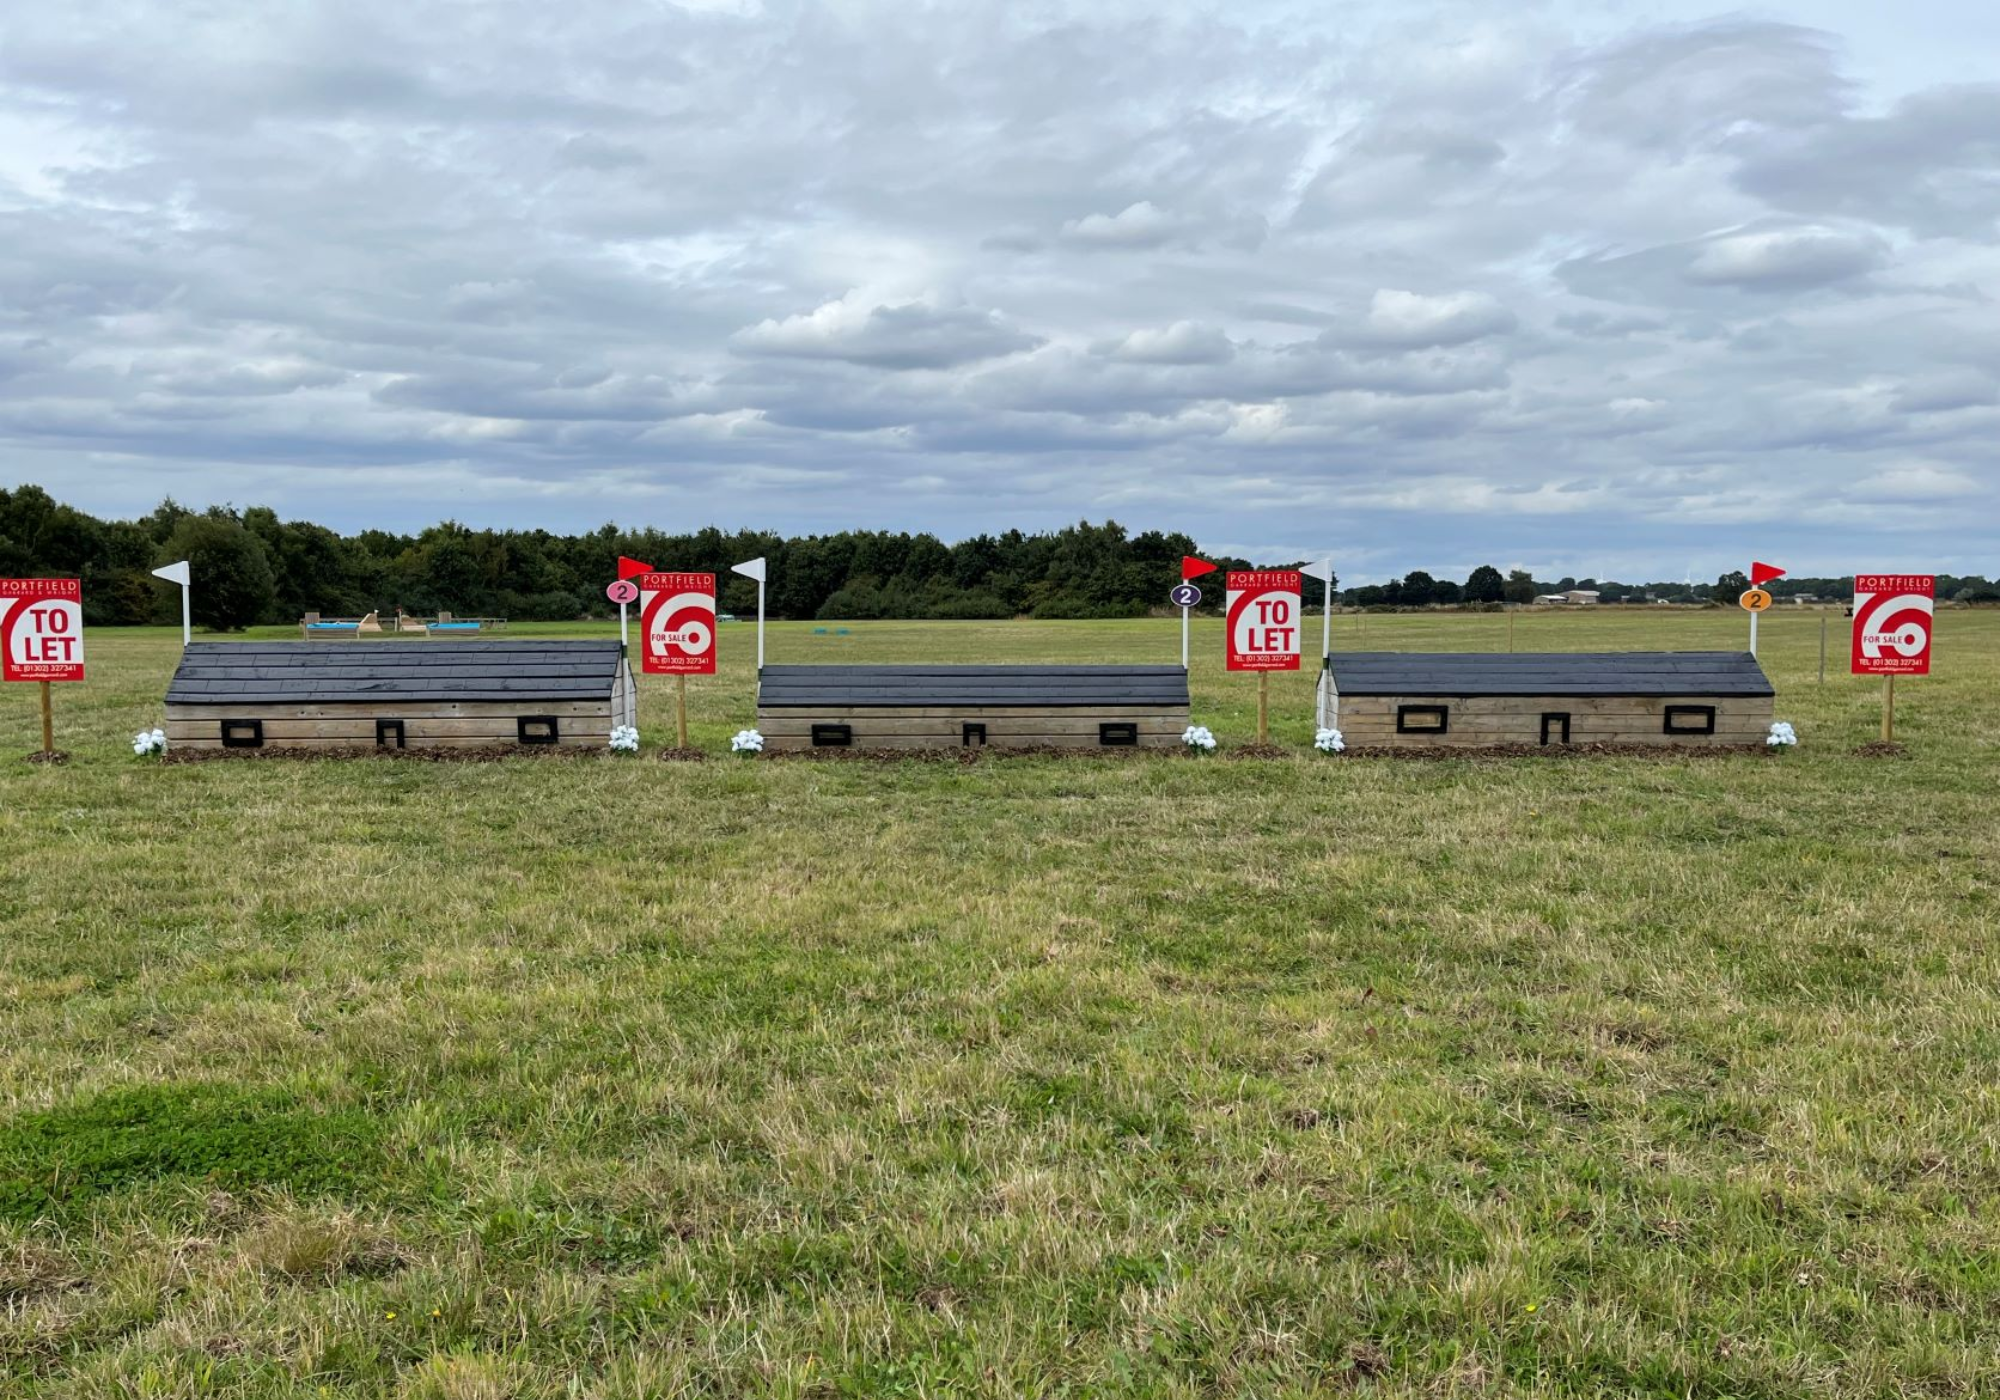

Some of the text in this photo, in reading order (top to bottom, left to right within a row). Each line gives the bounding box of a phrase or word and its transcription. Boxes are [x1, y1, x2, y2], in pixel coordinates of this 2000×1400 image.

[643, 575, 711, 585] PORTFIELD
[1230, 573, 1298, 583] PORTFIELD
[1859, 577, 1931, 587] PORTFIELD
[2, 581, 76, 590] PORTFIELD
[617, 585, 628, 599] 2
[1180, 588, 1191, 604] 2
[1750, 593, 1761, 608] 2
[1255, 600, 1289, 624] TO
[30, 608, 69, 634] TO
[1248, 628, 1294, 651] LET
[24, 637, 76, 661] LET
[23, 664, 49, 672] (01302)
